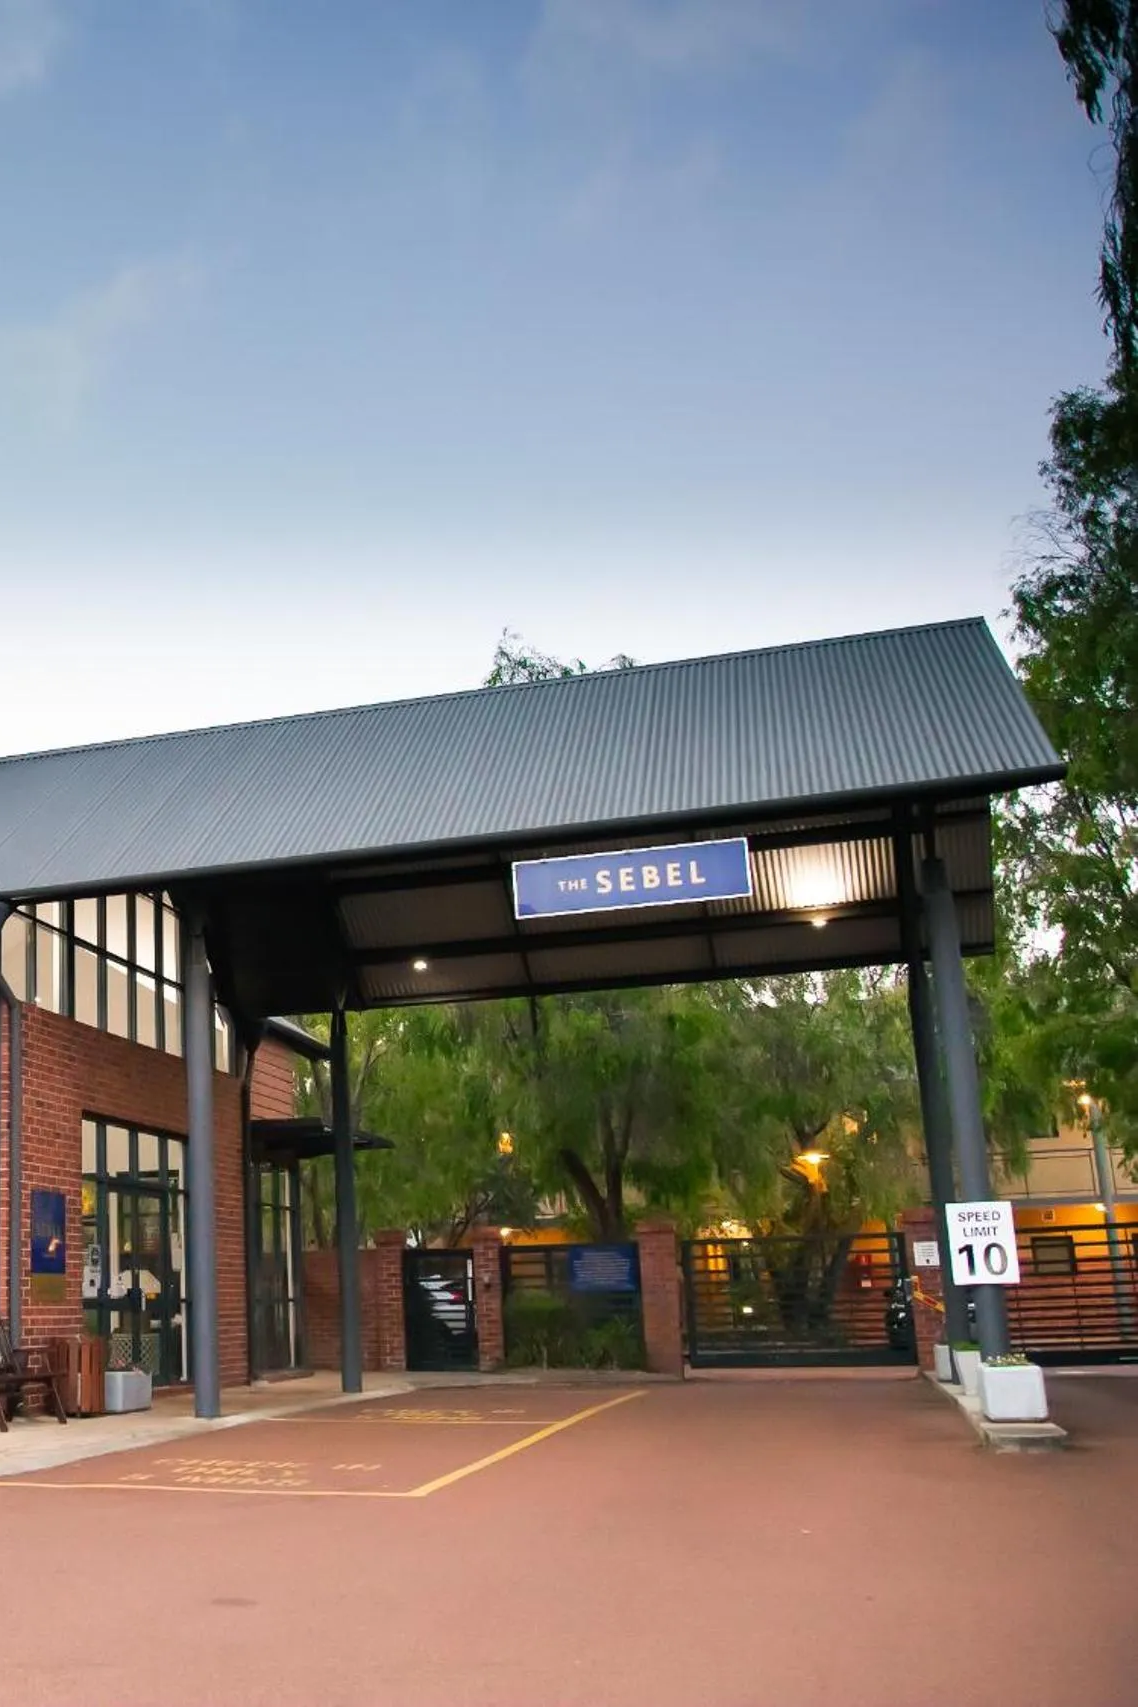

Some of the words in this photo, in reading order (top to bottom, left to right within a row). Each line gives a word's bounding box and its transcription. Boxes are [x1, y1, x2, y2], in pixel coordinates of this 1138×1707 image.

[558, 878, 587, 892] THE
[596, 860, 706, 894] SEBEL
[957, 1211, 1001, 1222] SPEED
[963, 1226, 998, 1237] LIMIT
[958, 1242, 1008, 1276] 10
